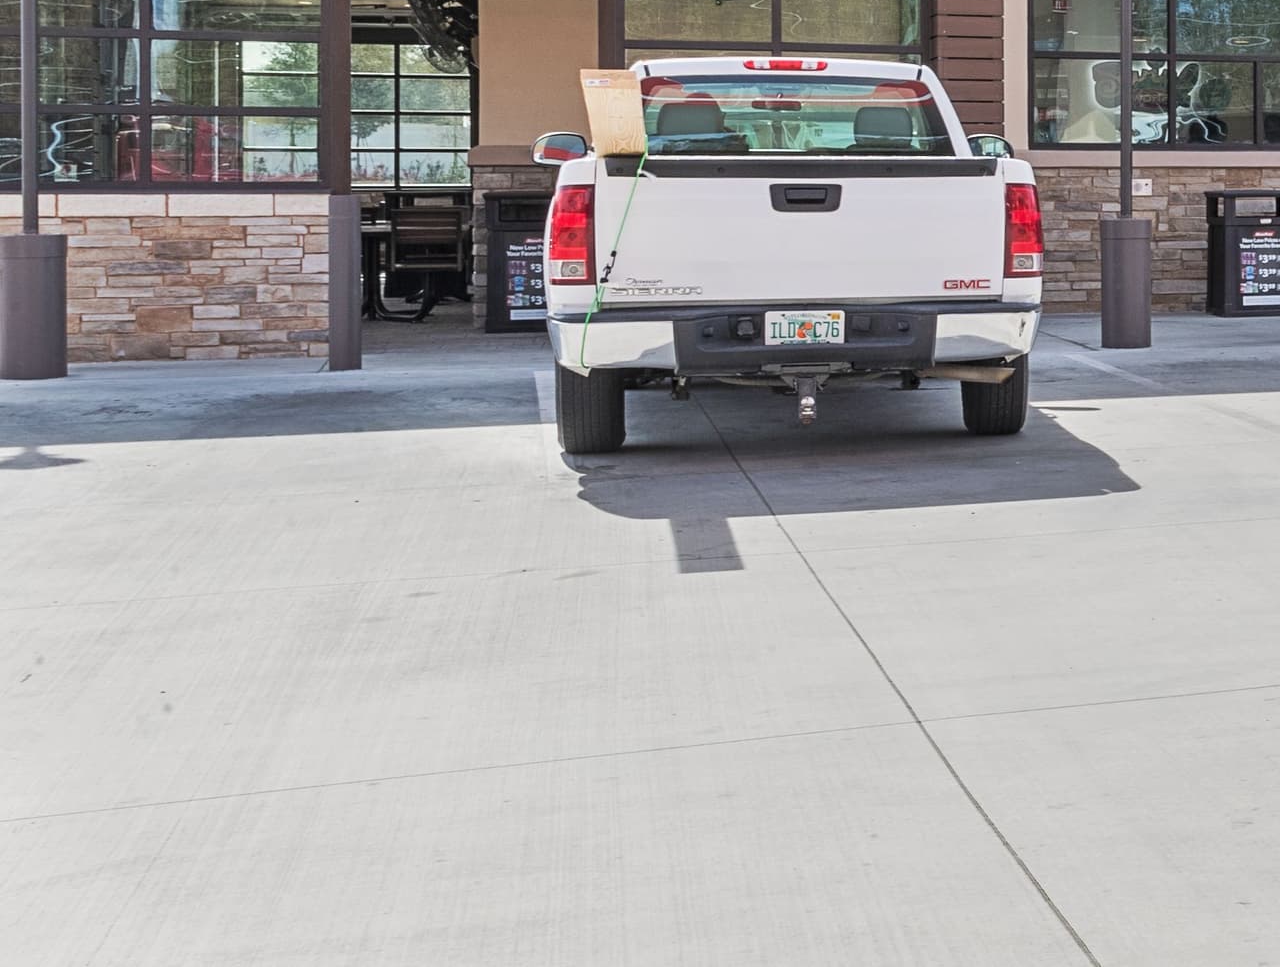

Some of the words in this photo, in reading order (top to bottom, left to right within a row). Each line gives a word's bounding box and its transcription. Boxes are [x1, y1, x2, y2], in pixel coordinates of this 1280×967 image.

[944, 279, 991, 290] GMC
[611, 287, 703, 296] SIERRA
[771, 322, 796, 338] ILD
[814, 321, 840, 338] C76
